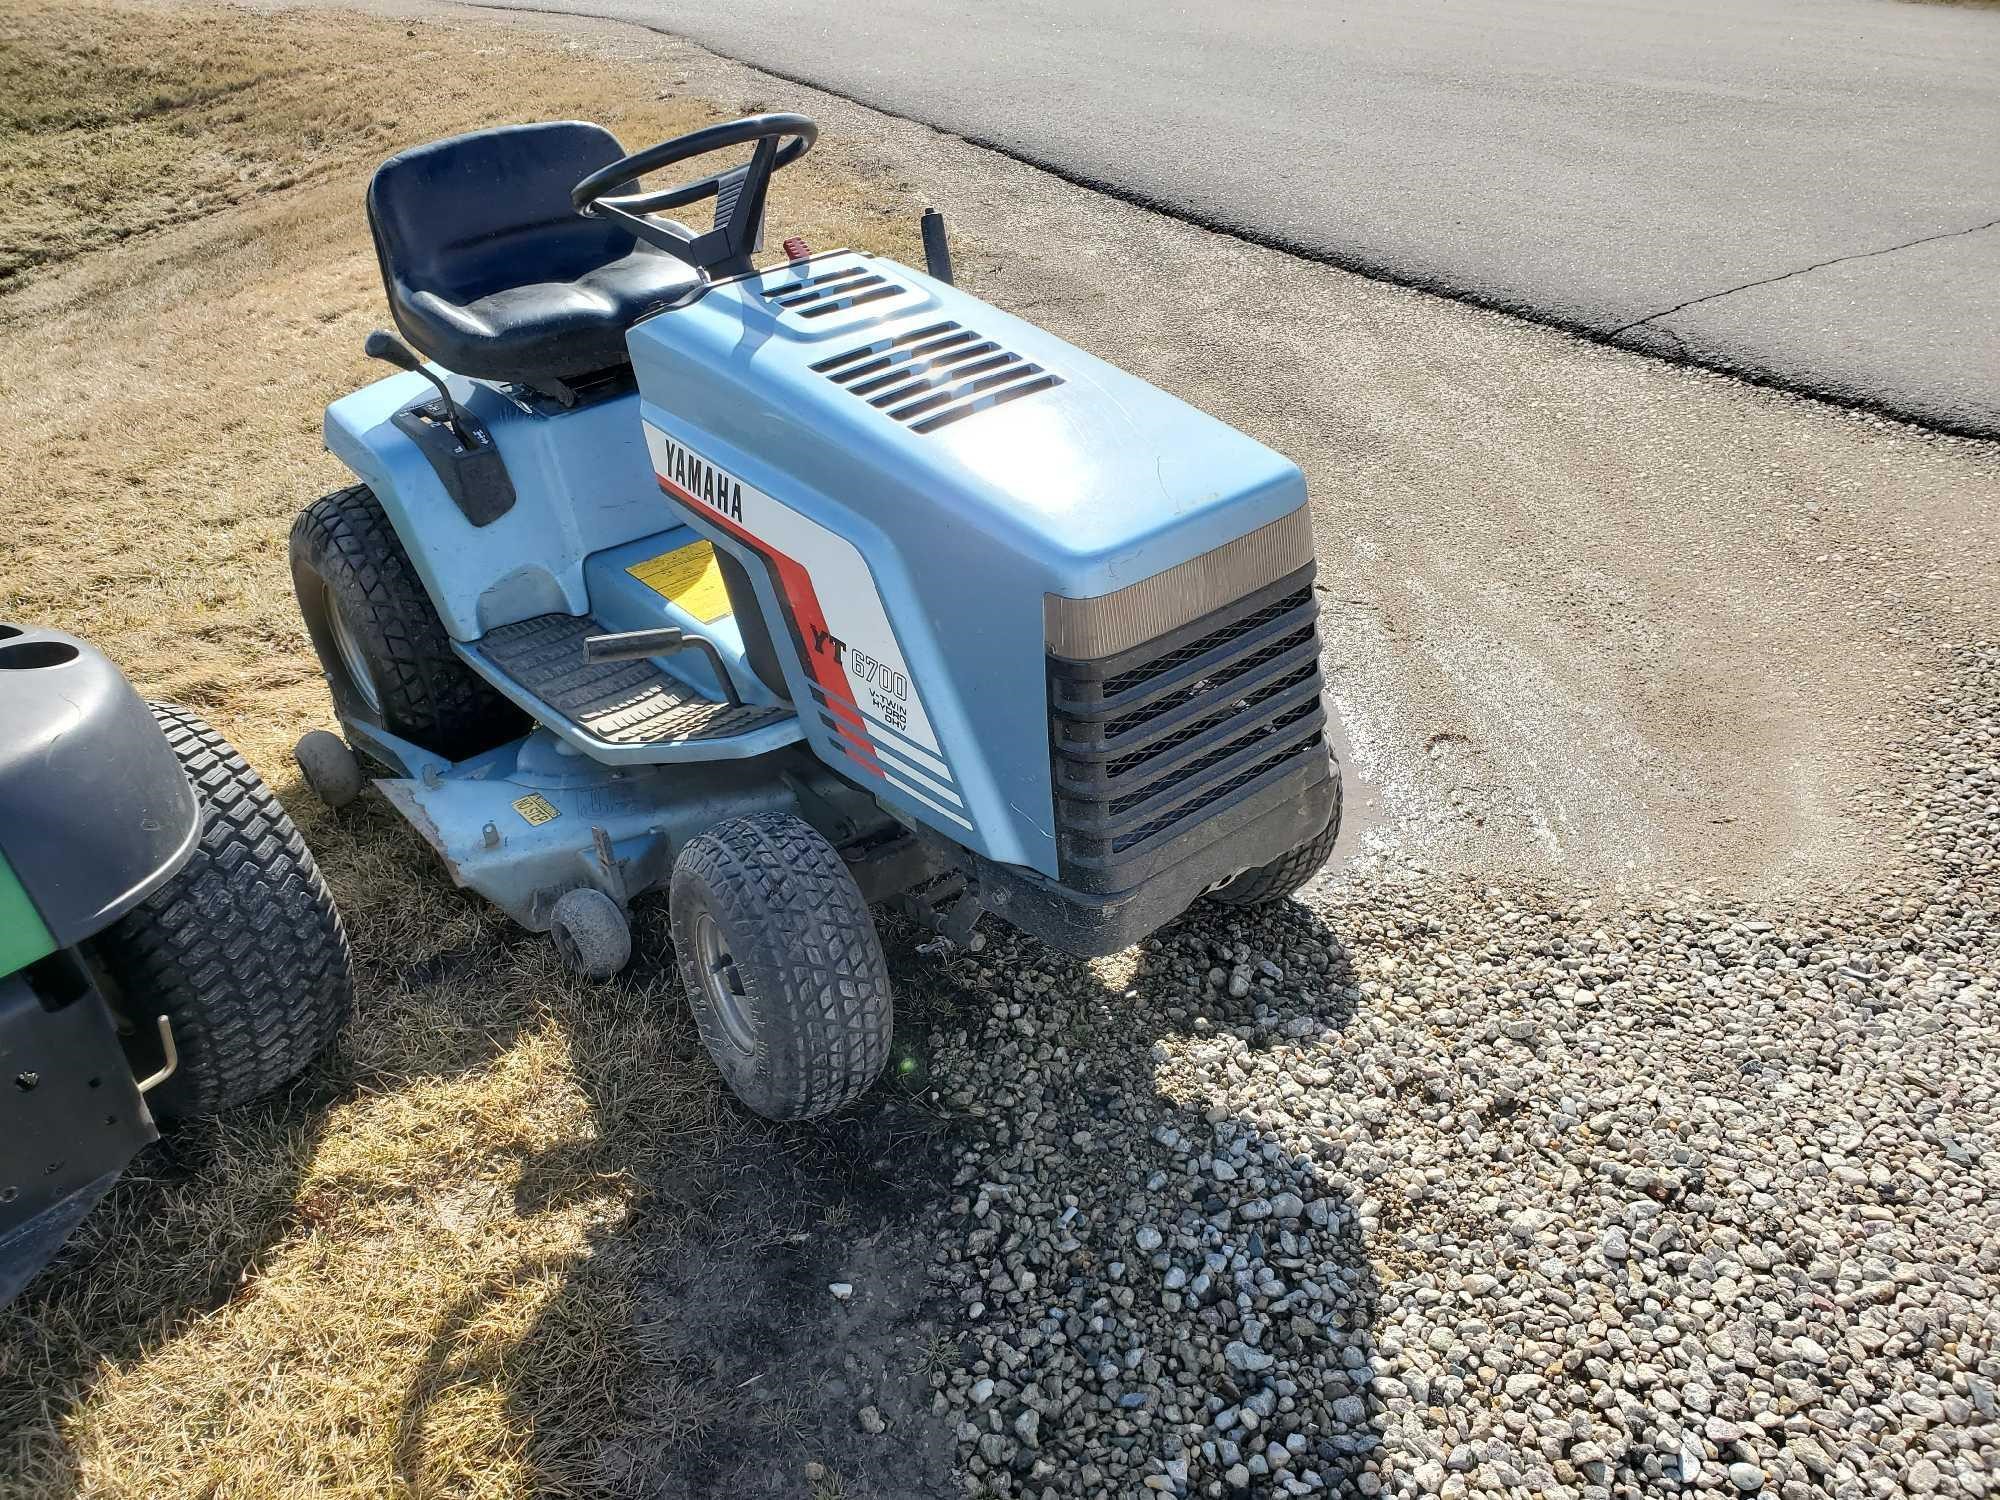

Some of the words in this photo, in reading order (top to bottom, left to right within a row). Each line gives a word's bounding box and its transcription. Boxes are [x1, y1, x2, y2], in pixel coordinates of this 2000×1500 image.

[665, 439, 743, 524] YAMAHA
[810, 623, 847, 666] YT
[851, 648, 908, 701] 6700
[869, 688, 907, 715] V-TWIN
[872, 699, 907, 724] HYDRO
